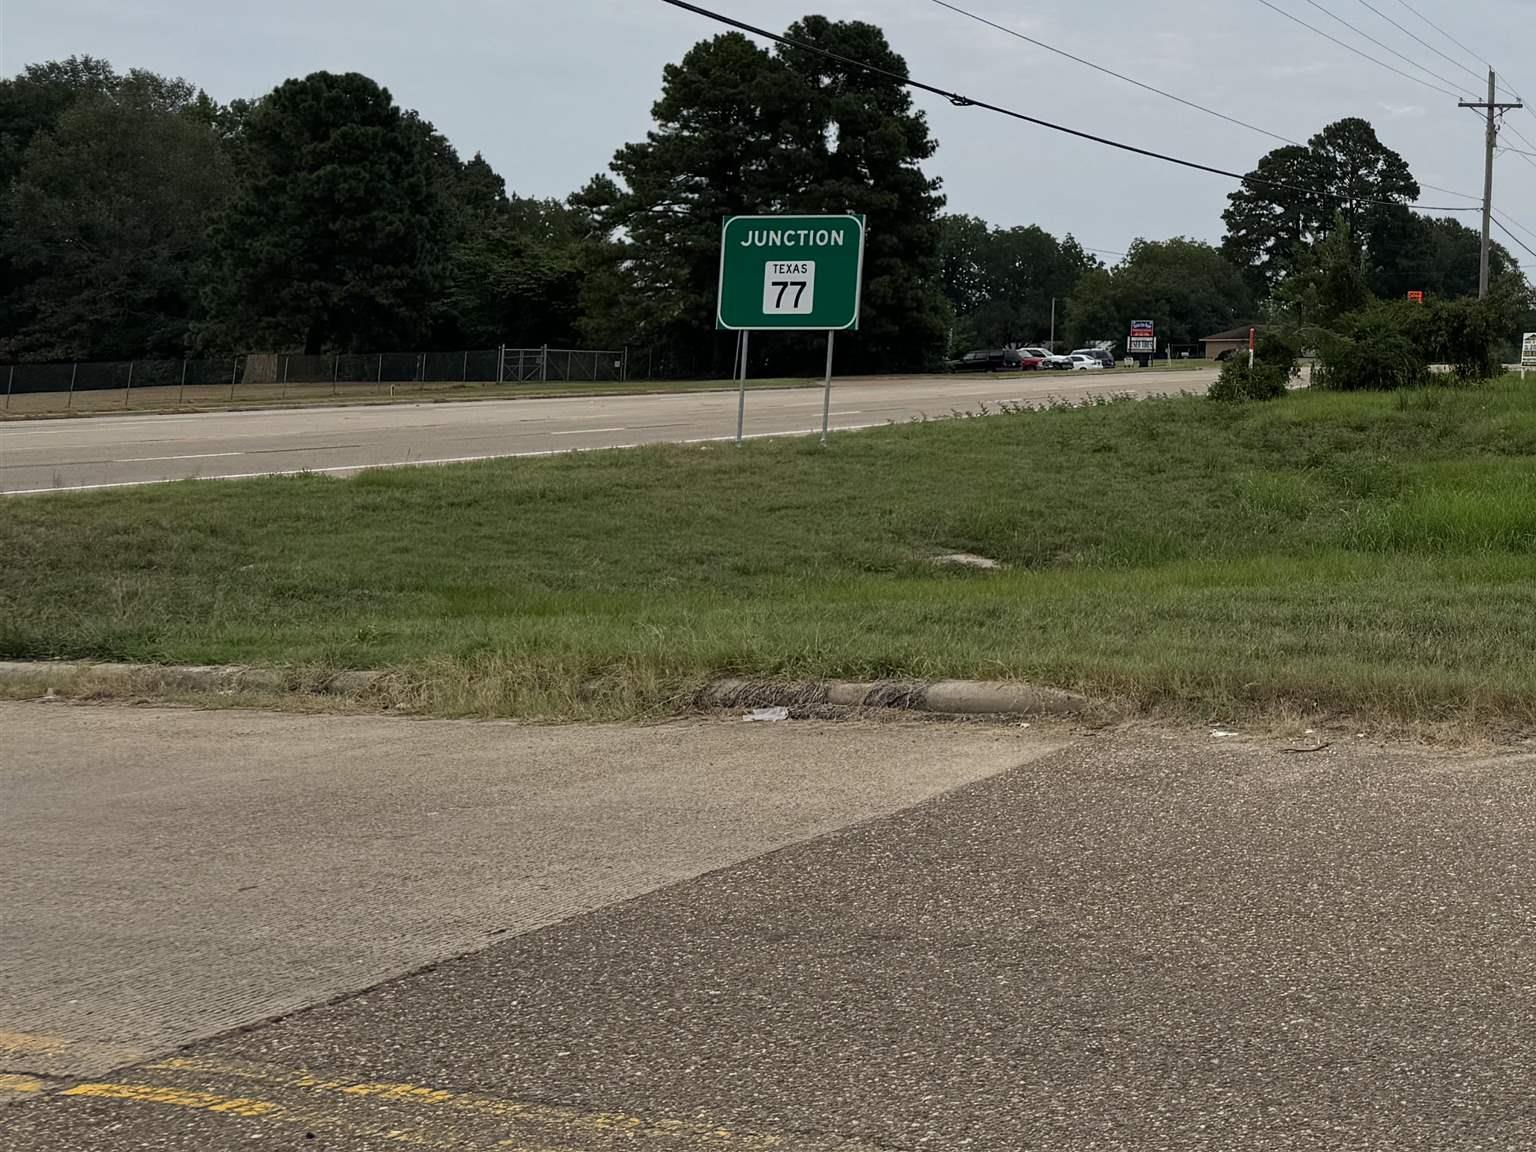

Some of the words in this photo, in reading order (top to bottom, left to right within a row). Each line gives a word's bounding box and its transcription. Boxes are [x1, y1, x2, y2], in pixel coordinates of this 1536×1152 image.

[740, 230, 844, 247] JUNCTION
[773, 264, 808, 274] TEXAS
[771, 281, 807, 309] 77
